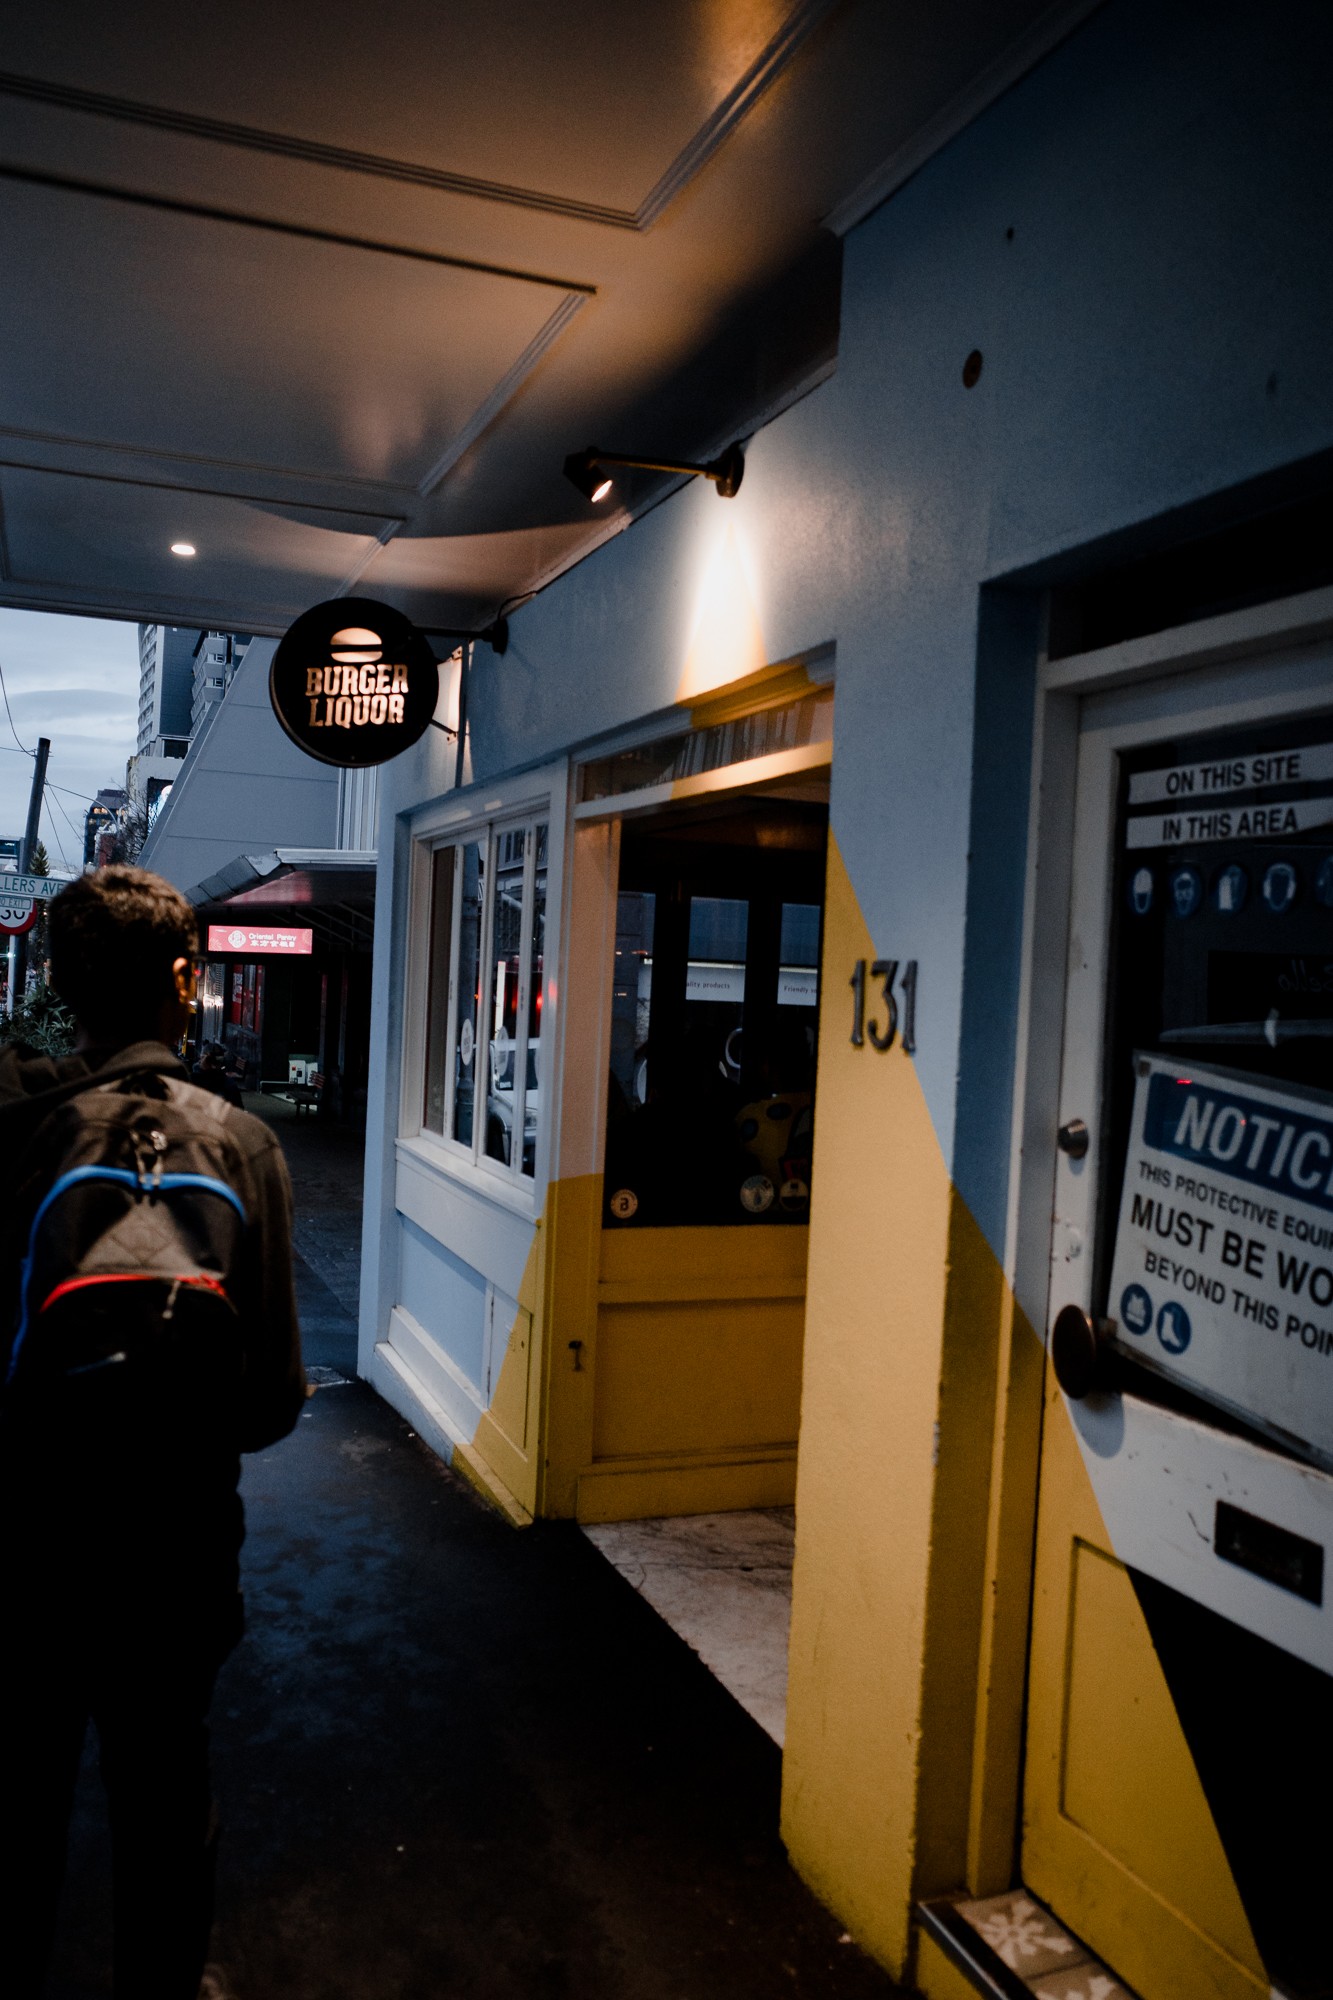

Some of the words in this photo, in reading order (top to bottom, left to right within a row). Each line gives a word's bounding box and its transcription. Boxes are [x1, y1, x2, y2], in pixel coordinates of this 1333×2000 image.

[305, 664, 409, 696] BURGER
[309, 694, 405, 729] LIQUOR
[1166, 772, 1193, 794] ON
[1200, 762, 1245, 789] THIS
[1253, 755, 1300, 783] SITE
[1163, 819, 1181, 841] IN
[1187, 813, 1231, 838] THIS
[1237, 808, 1297, 833] AREA
[0, 876, 36, 893] LERS
[249, 932, 274, 941] Oriental
[277, 933, 297, 943] Pantry
[849, 959, 918, 1054] 131
[1173, 1094, 1333, 1197] NOTIC
[1139, 1161, 1172, 1189] THIS
[1176, 1174, 1279, 1231] PROTECTIVE
[1131, 1194, 1214, 1254] MUST
[1222, 1230, 1267, 1279] BE
[1145, 1251, 1225, 1304] BEYOND
[1232, 1289, 1279, 1331] THIS
